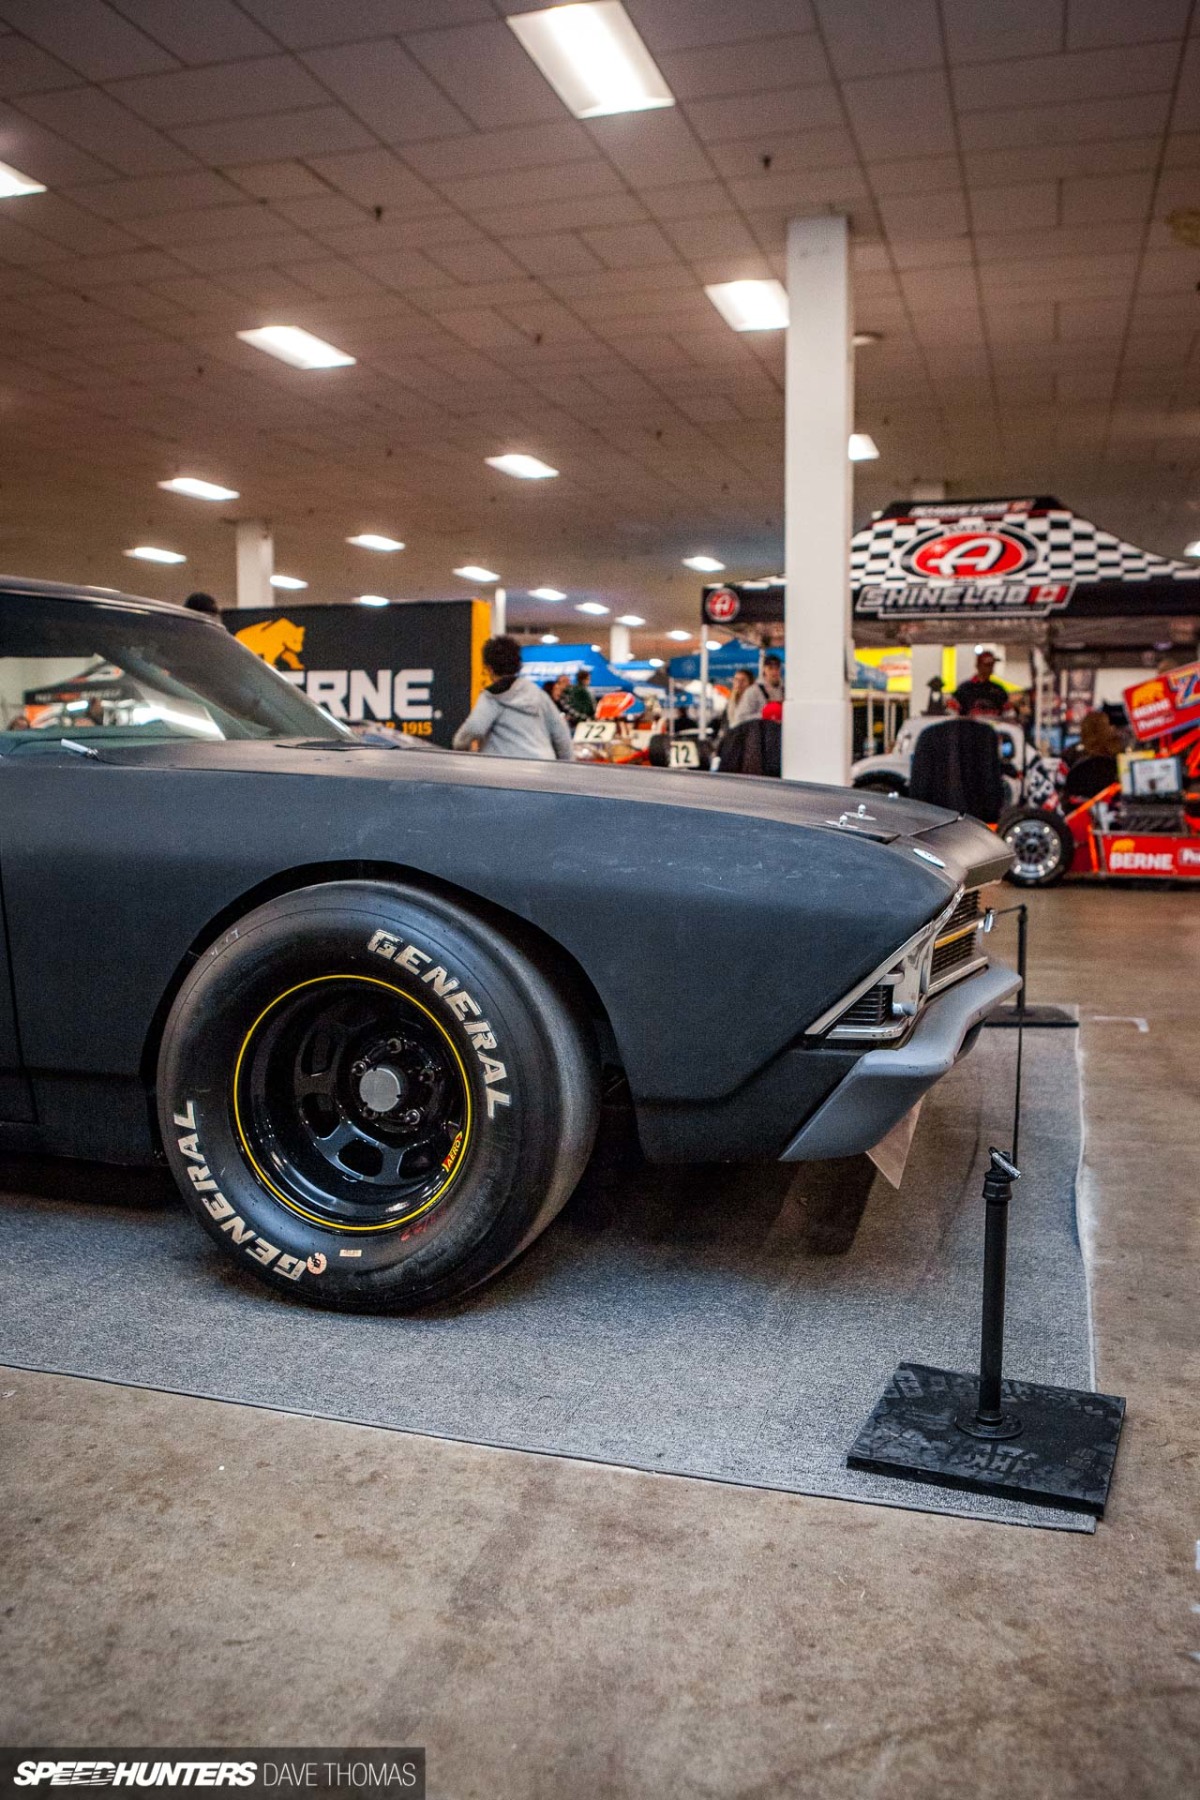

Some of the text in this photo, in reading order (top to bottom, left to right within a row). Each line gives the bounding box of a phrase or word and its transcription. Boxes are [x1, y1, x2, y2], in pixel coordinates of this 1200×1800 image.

[402, 721, 433, 736] 1915
[584, 725, 606, 739] 72
[367, 928, 511, 1120] GENERAL
[446, 1139, 461, 1168] AERO
[173, 1099, 308, 1282] GENERAL
